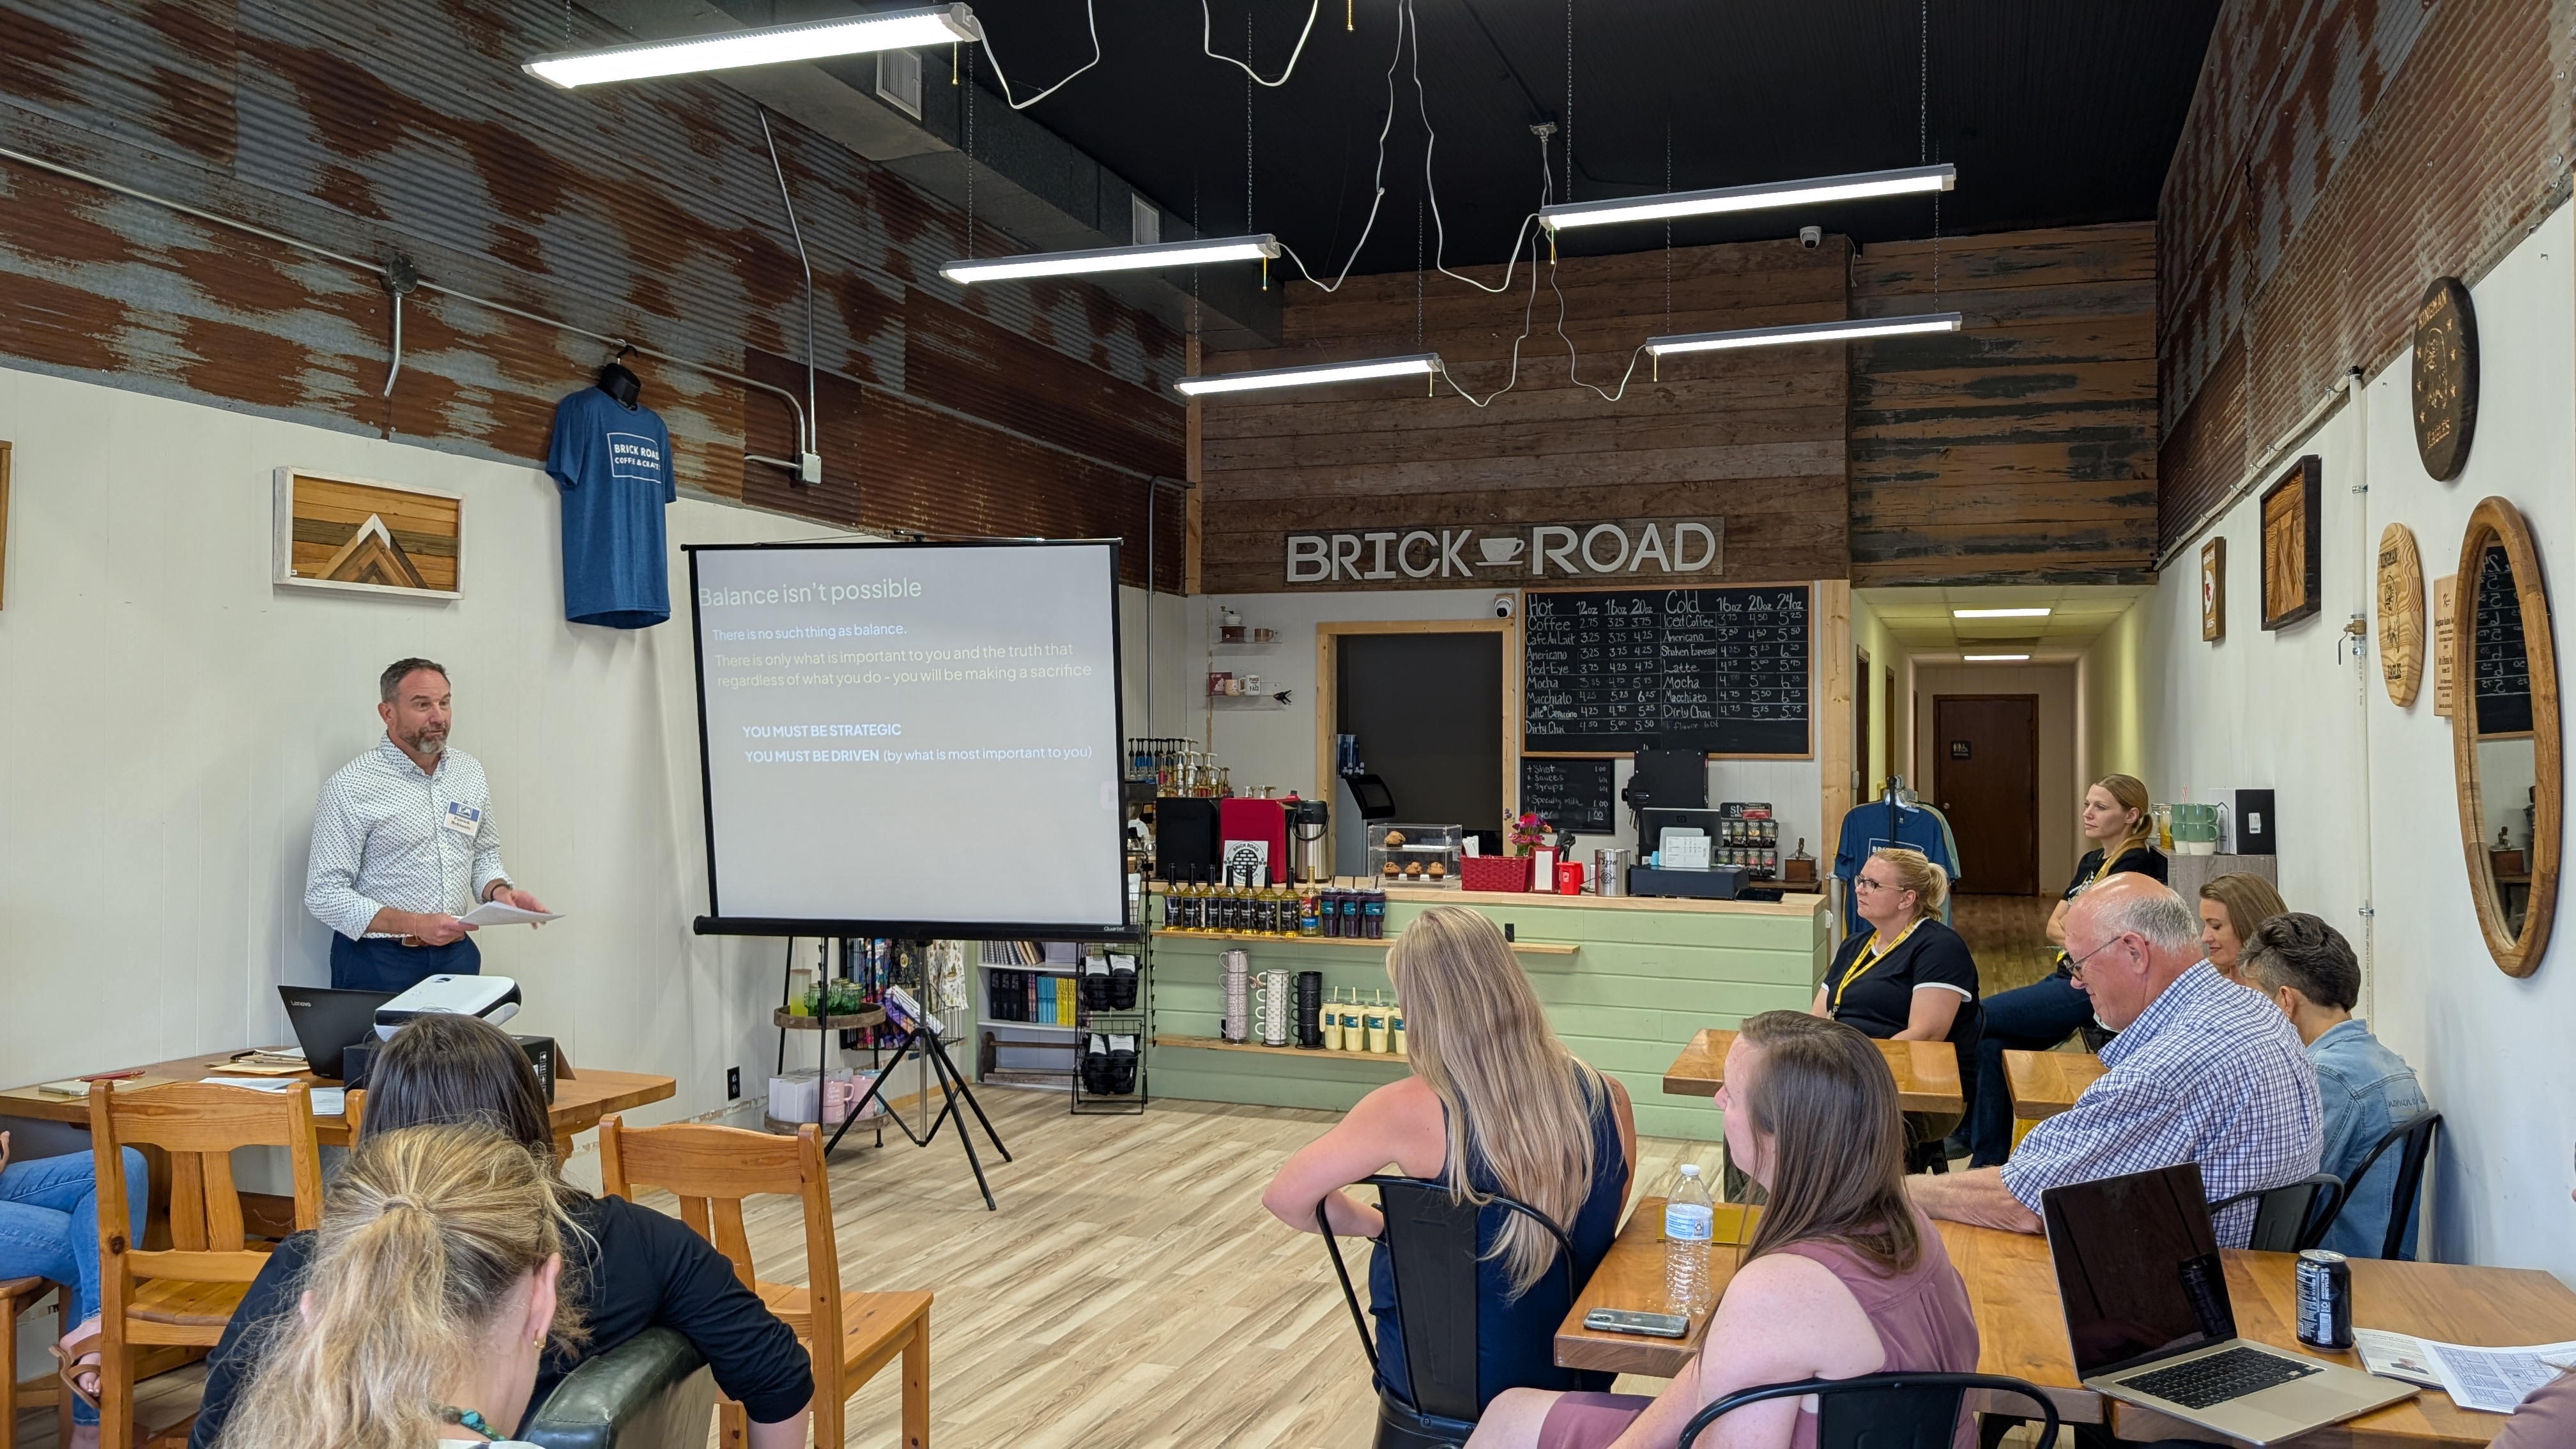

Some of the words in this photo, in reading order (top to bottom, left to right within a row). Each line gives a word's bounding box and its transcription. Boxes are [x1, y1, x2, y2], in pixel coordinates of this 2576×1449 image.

[2418, 287, 2448, 330] KINGMAN
[614, 444, 639, 456] BRICK
[1286, 530, 1474, 582] BRICK
[1532, 523, 1715, 575] ROAD
[698, 586, 779, 606] Balance
[782, 581, 827, 603] isn’t
[831, 576, 923, 605] possible
[1528, 594, 1554, 616] Hot
[1576, 601, 1598, 615] 12oz
[1605, 599, 1627, 615] 16oz
[1630, 599, 1653, 615] 20oz
[1665, 590, 1700, 613] Cold
[1716, 597, 1742, 612] 16oz
[1748, 594, 1773, 611] 20oz
[1776, 592, 1803, 610] 24oz
[1528, 616, 1570, 631] Coffee
[1580, 618, 1598, 628] 2.75
[1664, 614, 1684, 627] Iced
[1686, 614, 1714, 627] Coffee
[712, 629, 746, 641] There
[746, 629, 757, 640] is
[757, 630, 774, 640] no
[774, 626, 804, 639] such
[804, 625, 837, 640] thing
[838, 627, 853, 637] as
[854, 623, 908, 636] balance.
[1526, 631, 1547, 645] Cafe
[1557, 631, 1575, 645] Lait
[1580, 632, 1600, 643] 3.25
[1608, 632, 1626, 643] 3.75
[1634, 630, 1653, 642] 4.25
[1663, 629, 1704, 642] Americano
[715, 654, 750, 667] There
[752, 654, 763, 666] is
[764, 653, 793, 668] only
[793, 652, 827, 664] what
[827, 651, 839, 664] is
[839, 650, 907, 666] important
[907, 650, 924, 661] to
[924, 650, 951, 664] you
[953, 645, 981, 659] and
[982, 645, 1006, 658] the
[1008, 643, 1043, 657] truth
[1045, 643, 1075, 656] that
[1526, 646, 1567, 660] Americano
[1609, 646, 1627, 657] 3.75
[1634, 645, 1652, 656] 4.25
[1661, 645, 1689, 656] Shaken
[1690, 643, 1716, 656] Espresso
[1721, 645, 1740, 657] 4.25
[1526, 661, 1569, 675] Red-Eye
[1609, 663, 1627, 673] 4.25
[1635, 660, 1653, 672] 4.75
[1751, 659, 1768, 671] 5.00
[717, 673, 785, 689] regardless
[786, 673, 801, 686] of
[801, 672, 834, 685] what
[836, 673, 861, 687] you
[862, 670, 882, 684] do
[892, 672, 919, 686] you
[920, 668, 942, 682] will
[944, 668, 963, 681] be
[965, 666, 1018, 682] making
[1018, 668, 1028, 678] a
[1031, 663, 1092, 678] sacrifice
[1526, 676, 1558, 689] Mocha
[1663, 675, 1699, 689] Mocha
[1526, 689, 1572, 705] Macchiato
[1610, 690, 1629, 702] 5.25
[1637, 690, 1656, 702] 6.25
[1664, 689, 1707, 703] Macchiato
[1720, 690, 1740, 700] 4.75
[1751, 690, 1771, 702] 5.50
[1781, 690, 1800, 703] 6.25
[1581, 706, 1598, 717] 4.25
[1609, 705, 1627, 716] 4.75
[1663, 704, 1689, 718] Dirty
[1690, 704, 1712, 718] Chai
[1721, 705, 1740, 716] 4.75
[1780, 705, 1802, 718] 5.75
[742, 726, 772, 738] YOU
[772, 725, 809, 737] MUST
[809, 724, 829, 737] BE
[829, 723, 903, 737] STRATEGIC
[1526, 719, 1546, 735] Dirty
[1548, 721, 1565, 734] Chai
[1579, 721, 1597, 732] 4.50
[1610, 719, 1627, 731] 5.00
[1634, 719, 1654, 732] 5.50
[1673, 721, 1698, 730] flavor
[744, 751, 774, 763] YOU
[774, 750, 811, 762] MUST
[812, 749, 831, 762] BE
[831, 749, 880, 762] DRIVEN
[882, 749, 903, 764] (by
[903, 749, 935, 761] what
[935, 749, 947, 760] is
[947, 749, 981, 760] most
[982, 747, 1046, 762] important
[1046, 747, 1062, 758] to
[1062, 745, 1093, 761] you)
[1533, 764, 1556, 774] Shot
[1534, 783, 1564, 793] Syrups
[1593, 799, 1608, 808] 1.00
[1233, 843, 1246, 852] BRICK
[1247, 843, 1259, 852] ROAD
[1597, 856, 1618, 868] Tips
